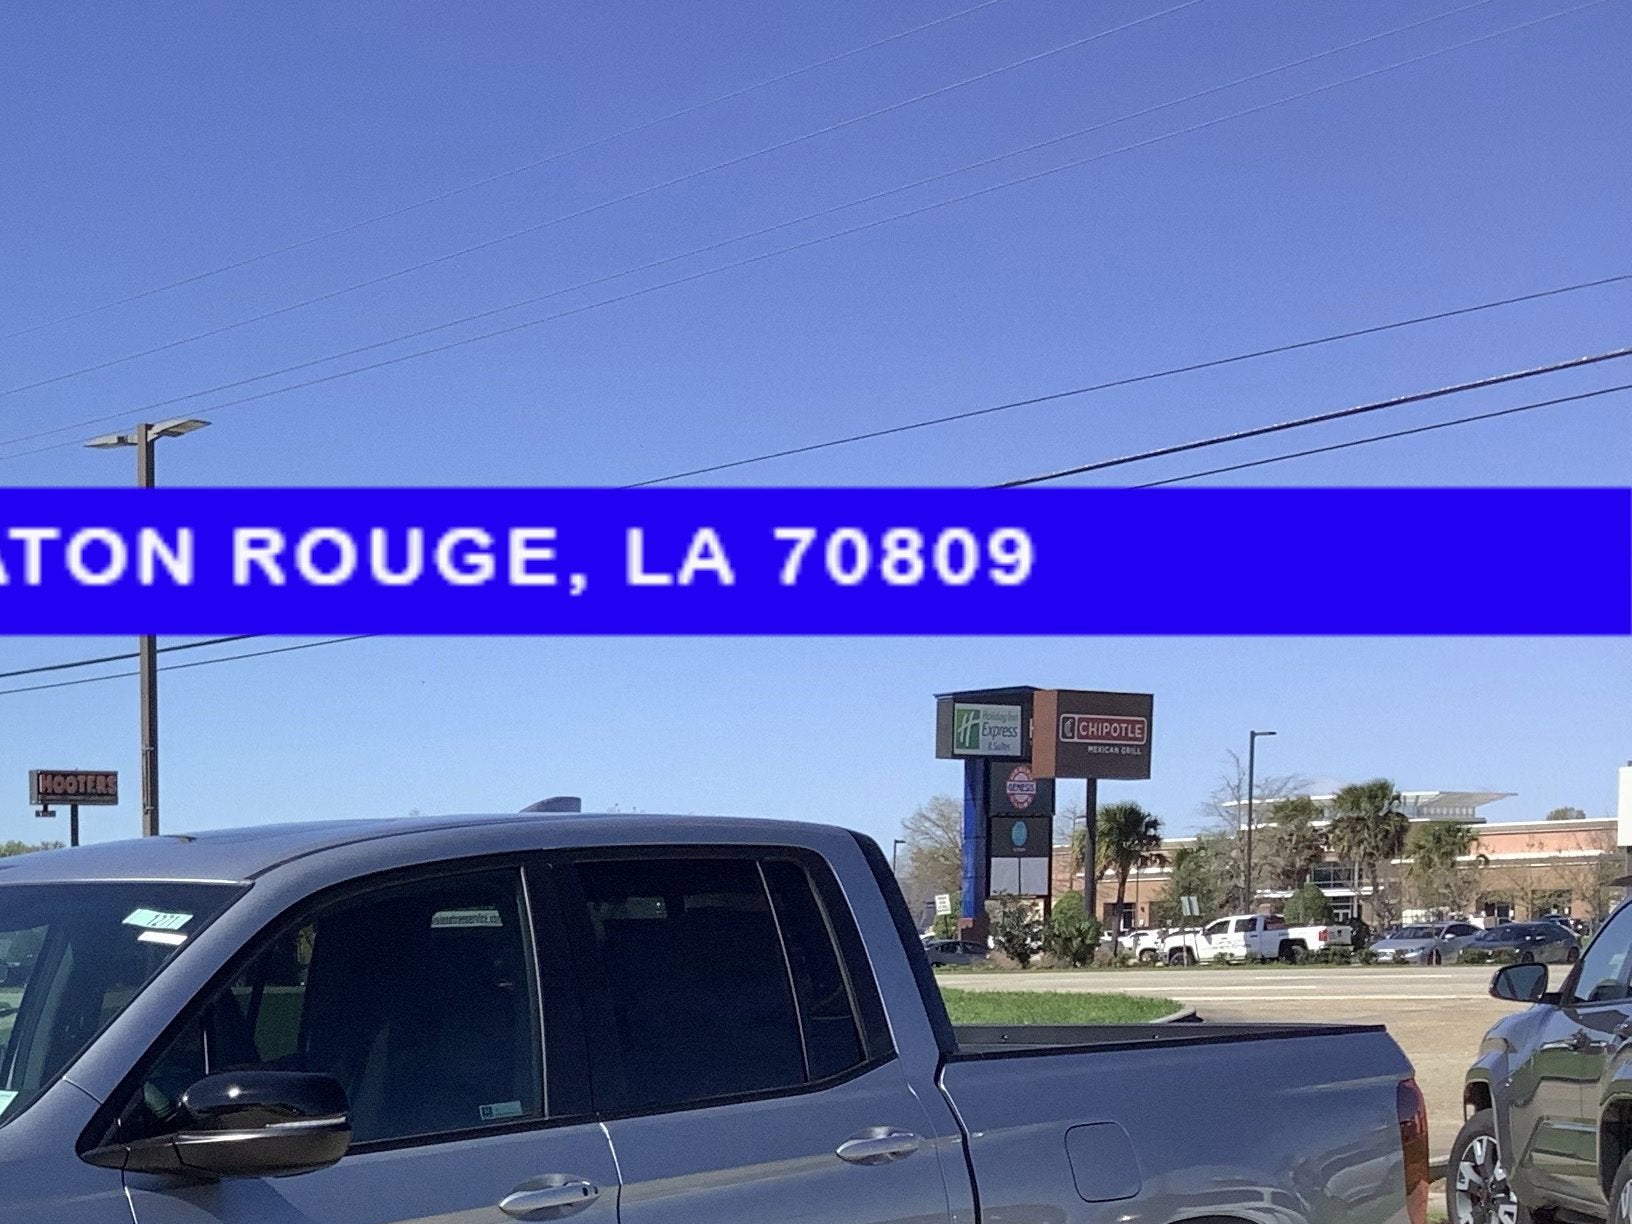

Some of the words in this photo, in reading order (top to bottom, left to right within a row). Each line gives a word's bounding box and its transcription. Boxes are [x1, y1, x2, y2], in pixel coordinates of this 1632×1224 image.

[982, 722, 1018, 740] Express
[1079, 721, 1143, 738] CHIPOTLE
[1088, 745, 1119, 753] MEXICAN
[1121, 747, 1142, 755] GRILL
[39, 774, 117, 794] HOOTERS
